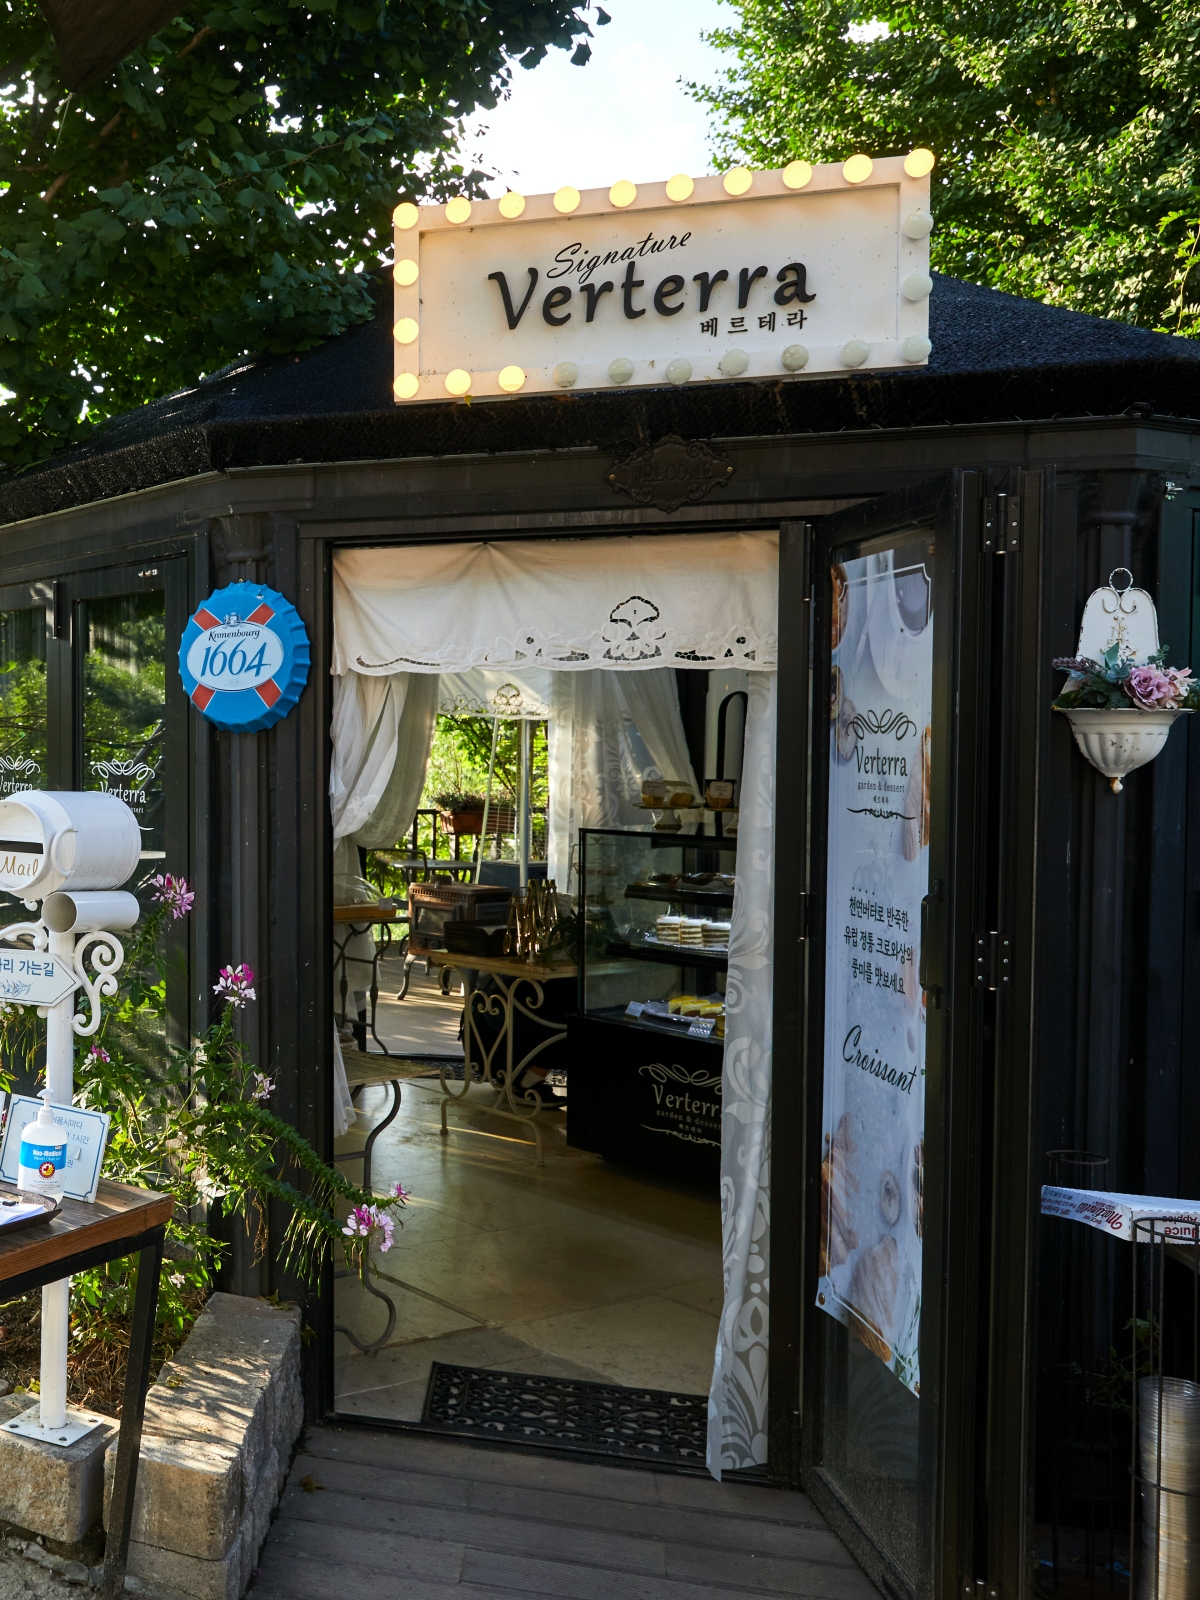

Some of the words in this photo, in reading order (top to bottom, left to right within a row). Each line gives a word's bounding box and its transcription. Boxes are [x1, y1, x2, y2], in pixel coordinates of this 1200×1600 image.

[546, 231, 692, 285] Signature
[488, 260, 817, 331] Verterra
[700, 309, 808, 338] 베르테라
[631, 460, 713, 484] WELCOME
[208, 629, 261, 643] Kronenbourg
[200, 638, 271, 678] 1664
[855, 745, 908, 777] Verterra
[857, 781, 877, 791] garden
[883, 782, 905, 793] dessert
[849, 896, 885, 922] 천연버터로
[887, 906, 909, 932] 반죽한
[843, 925, 858, 948] 유럽
[859, 930, 875, 953] 정통
[876, 937, 913, 967] 크로와상의
[18, 959, 55, 978] 가는길
[851, 958, 873, 984] 풍미를
[875, 966, 906, 995] 맛보세요
[843, 1025, 918, 1095] Croissant
[651, 1083, 722, 1118] Verterr
[656, 1109, 684, 1121] garden
[694, 1117, 722, 1130] desser
